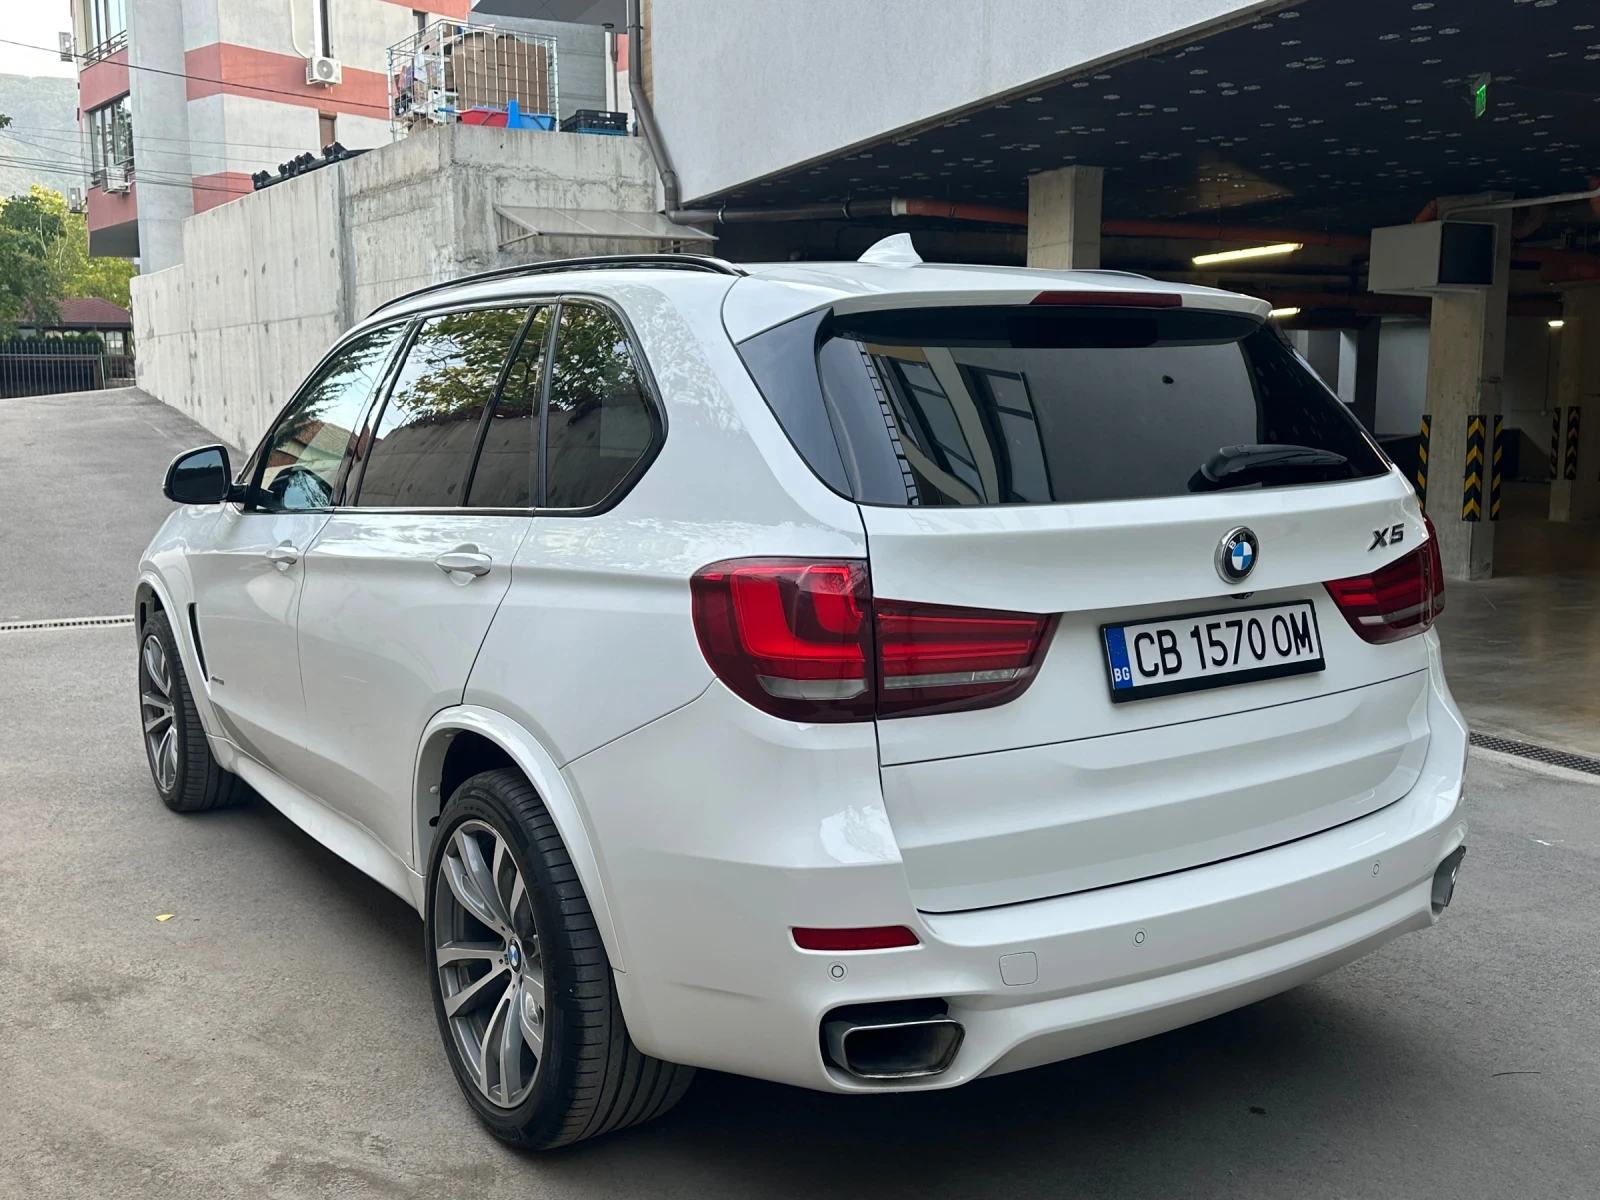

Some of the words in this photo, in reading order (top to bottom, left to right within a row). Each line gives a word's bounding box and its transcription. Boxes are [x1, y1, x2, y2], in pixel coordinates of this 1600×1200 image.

[1367, 523, 1405, 552] X5
[1134, 629, 1183, 678] CB
[1189, 617, 1267, 670] 1570
[1271, 611, 1314, 657] OM
[1113, 666, 1130, 682] BG
